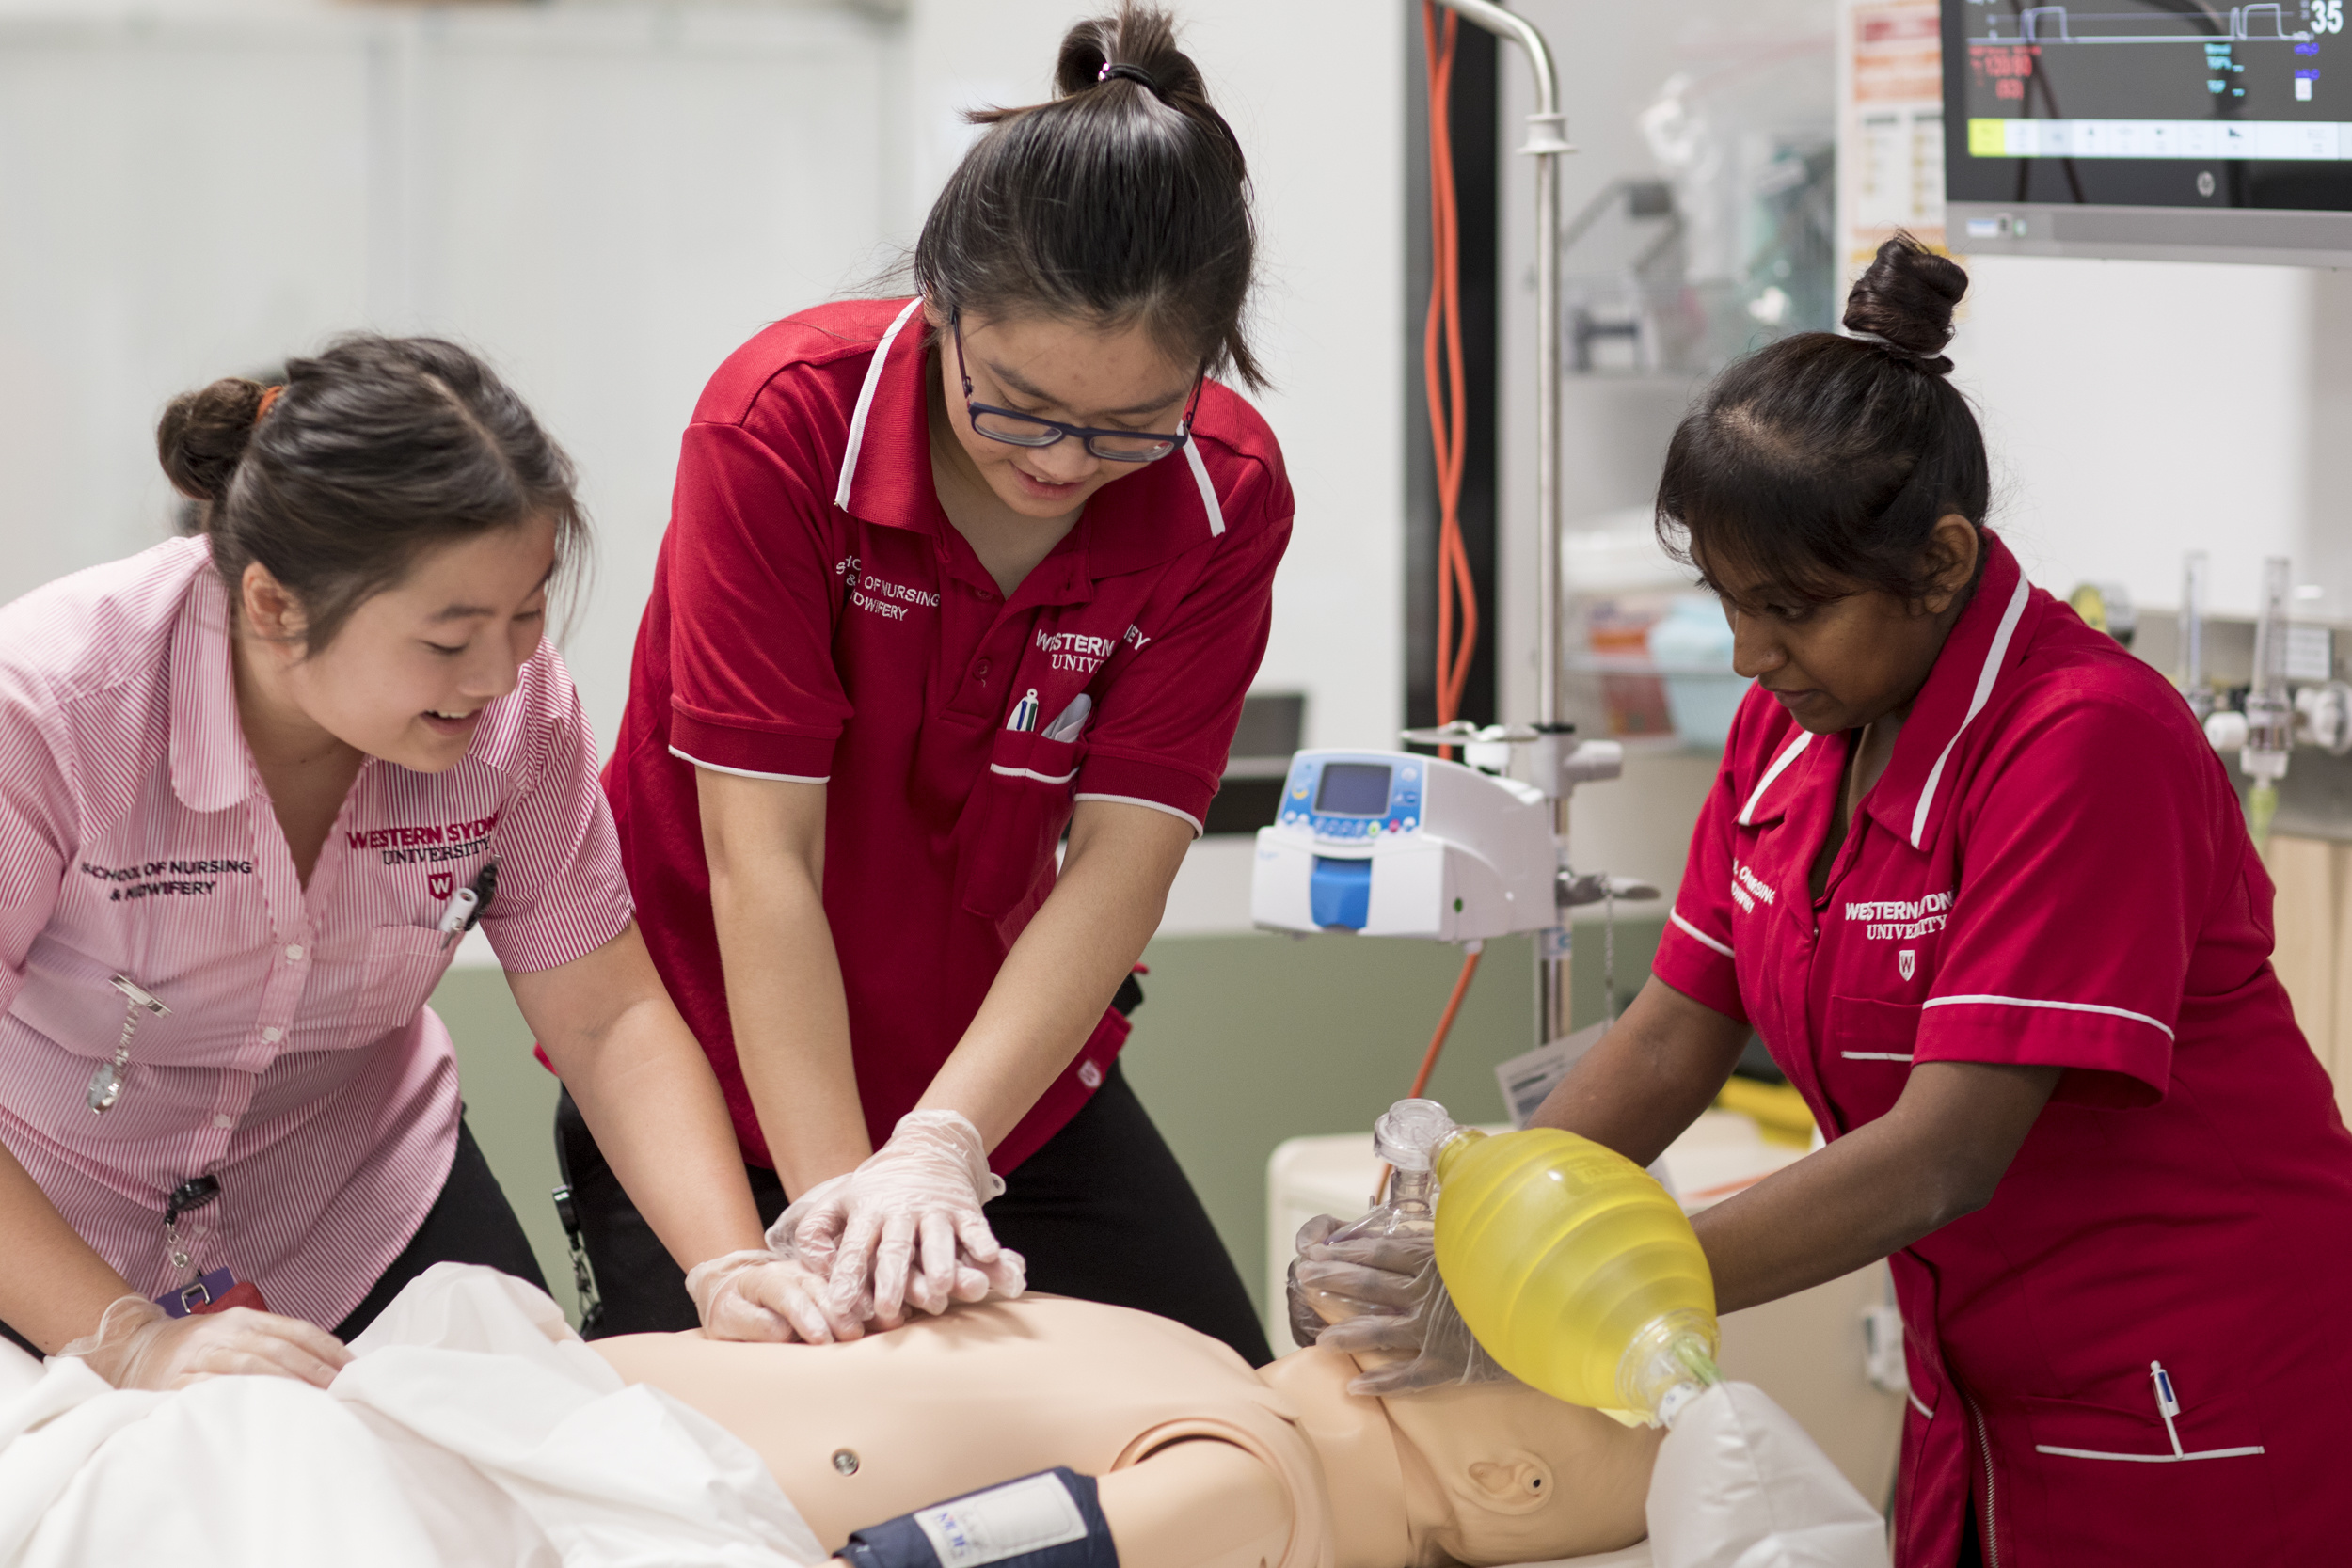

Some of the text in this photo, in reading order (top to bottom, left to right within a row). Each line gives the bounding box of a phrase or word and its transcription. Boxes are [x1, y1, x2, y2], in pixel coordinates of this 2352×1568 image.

[2311, 0, 2344, 34] 35
[846, 573, 856, 587] &
[864, 575, 882, 592] OF
[881, 579, 941, 607] NURSING
[346, 804, 502, 849] WESTERN SYDN
[381, 835, 491, 865] UNIVERSITY
[144, 861, 167, 877] OF
[169, 859, 252, 875] NURSING
[1845, 901, 1919, 921] WESTERN
